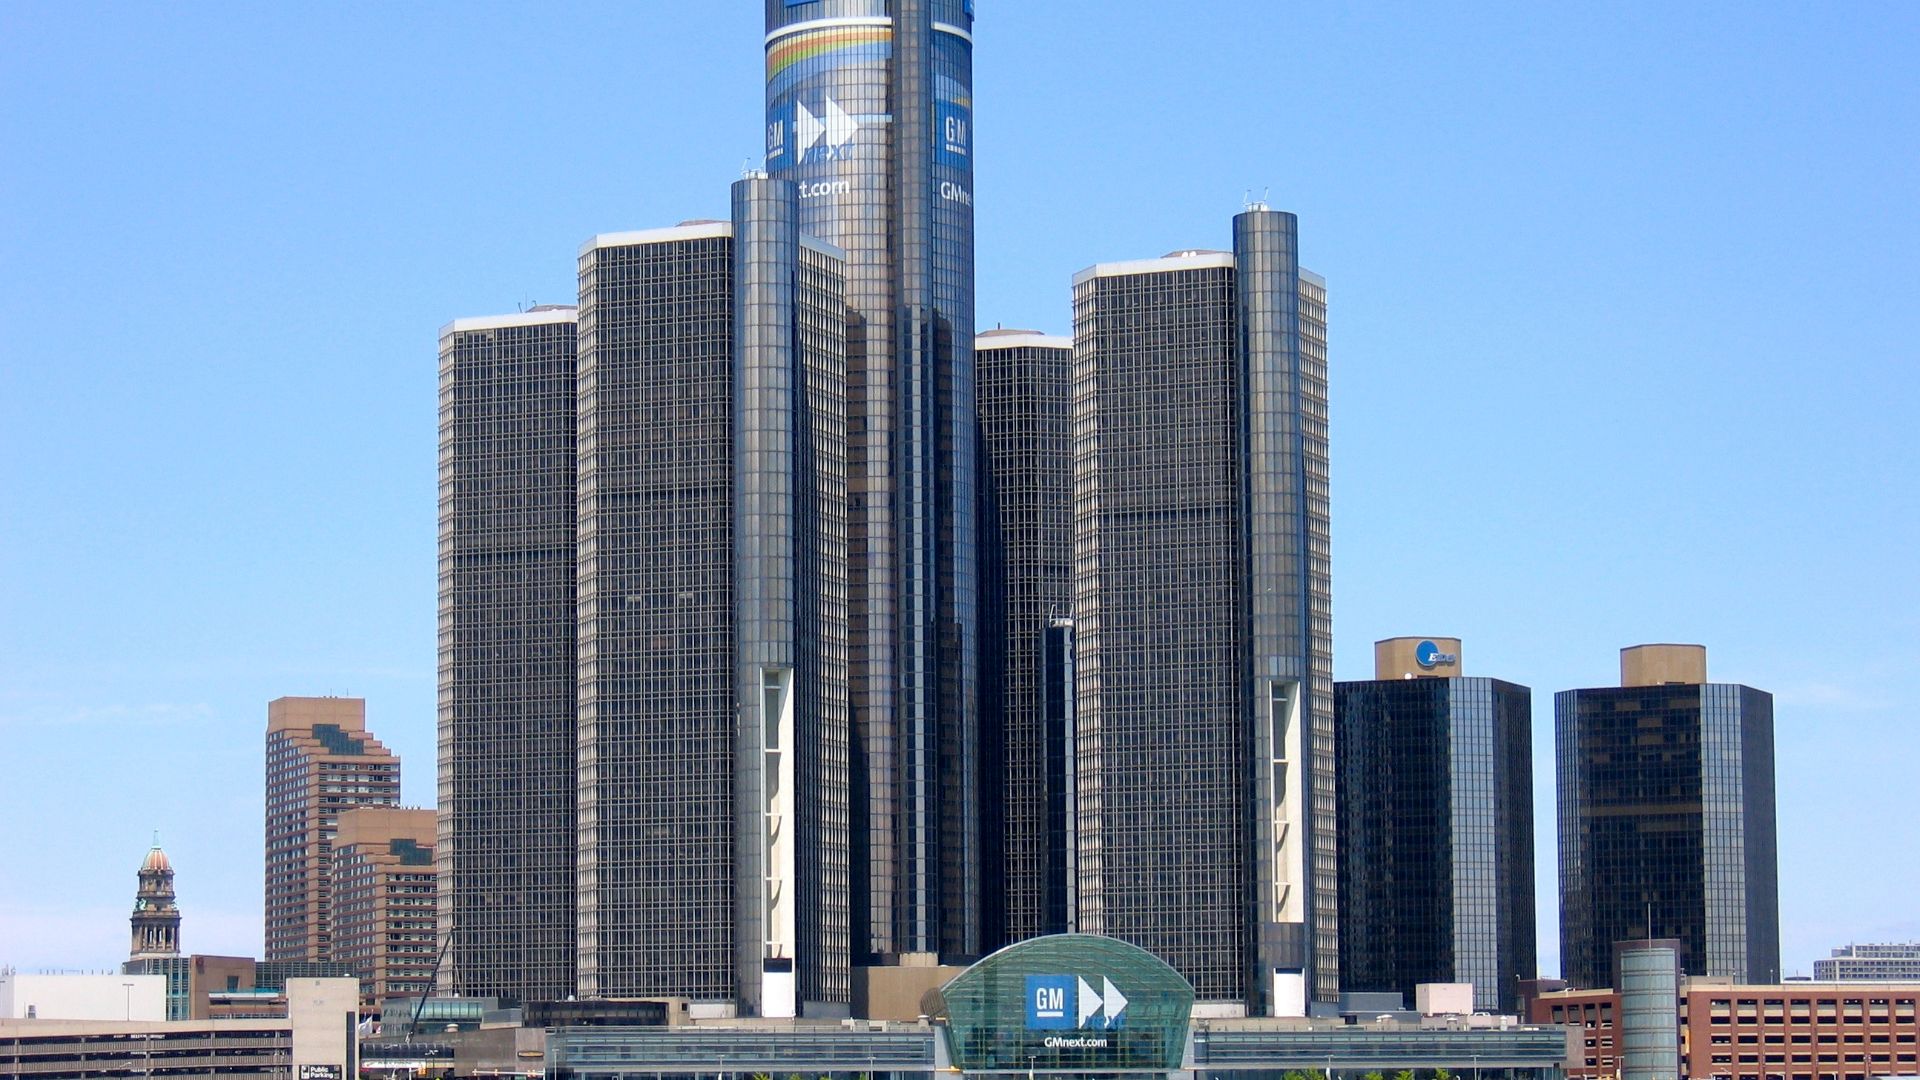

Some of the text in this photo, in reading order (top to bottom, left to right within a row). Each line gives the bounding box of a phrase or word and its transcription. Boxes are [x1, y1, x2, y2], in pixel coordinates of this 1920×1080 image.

[768, 120, 783, 150] GM
[945, 116, 967, 146] GM
[798, 180, 850, 199] t.com
[1036, 987, 1064, 1010] GM
[1044, 1036, 1108, 1048] GMnext.com
